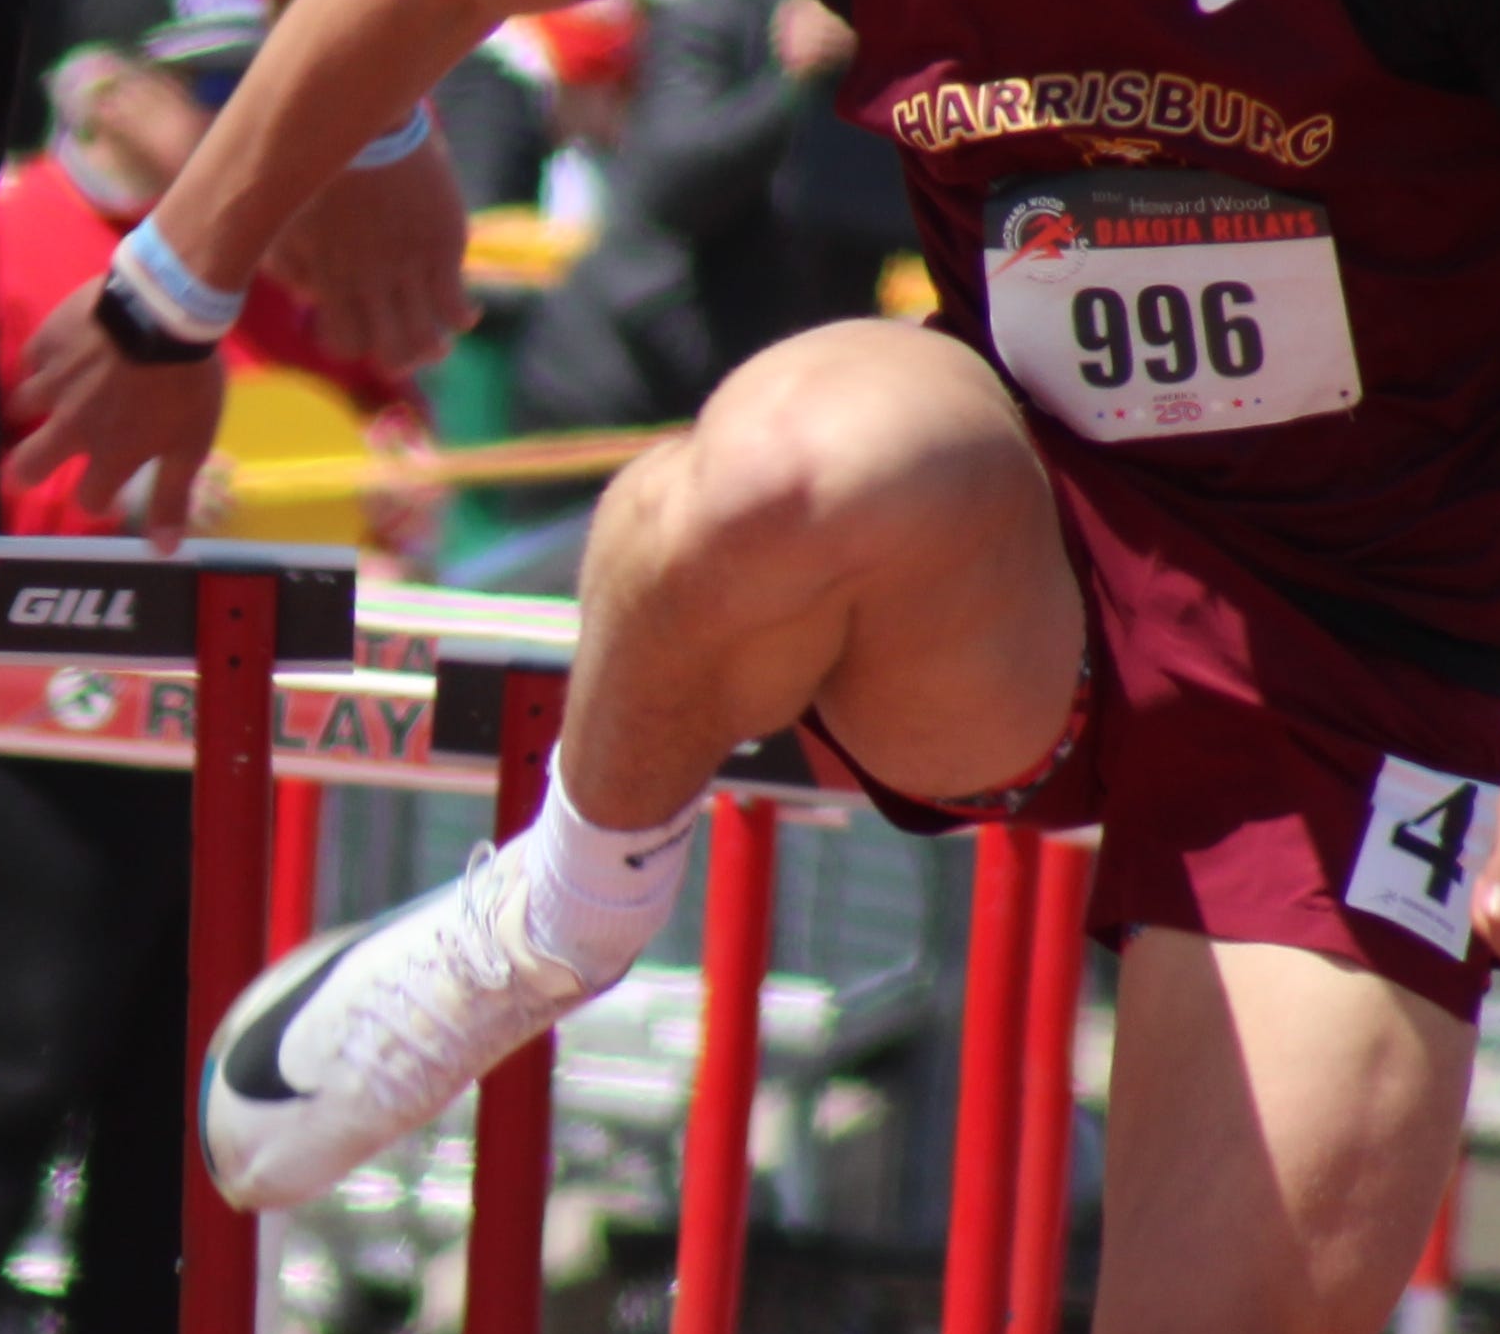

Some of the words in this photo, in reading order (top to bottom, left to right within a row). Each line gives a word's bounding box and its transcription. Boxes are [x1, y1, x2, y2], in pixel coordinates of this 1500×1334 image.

[893, 72, 1333, 167] HARRISBURG
[1095, 216, 1202, 247] DAKOTA
[1211, 208, 1318, 243] RELAYS
[1129, 197, 1205, 215] Howard
[1211, 195, 1271, 212] Wood
[1073, 280, 1264, 388] 996
[8, 586, 138, 630] GILL
[146, 681, 431, 757] RLAY
[1391, 780, 1478, 907] 4
